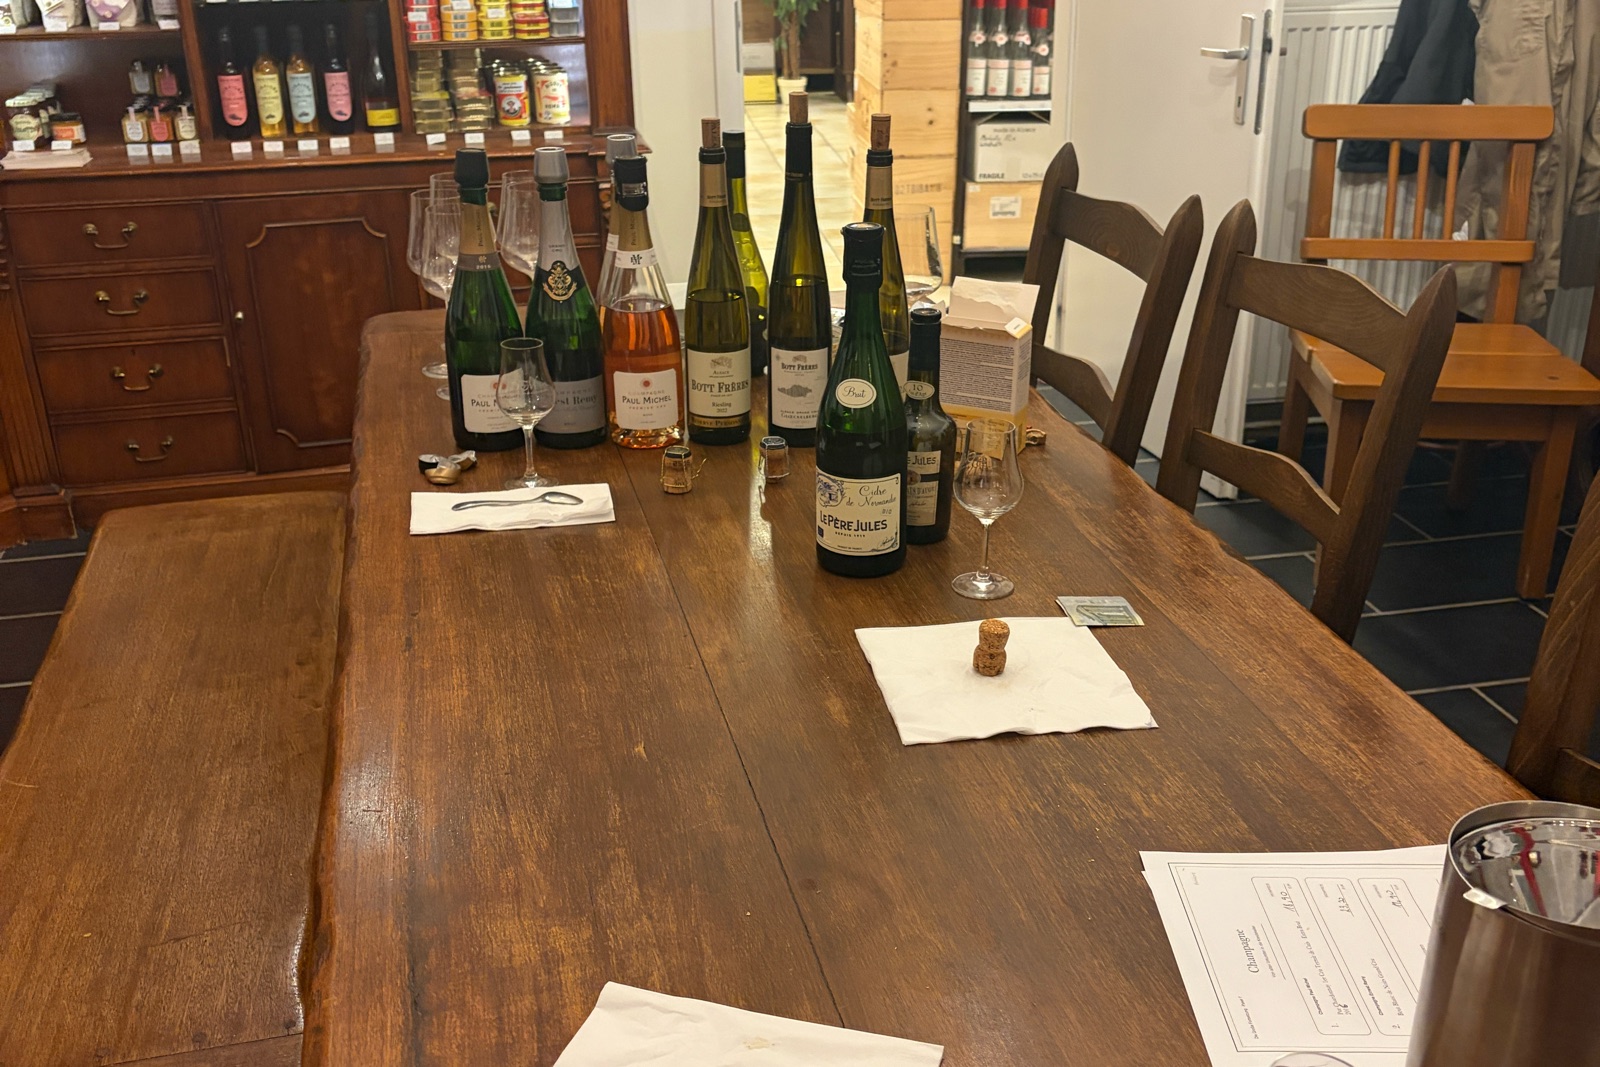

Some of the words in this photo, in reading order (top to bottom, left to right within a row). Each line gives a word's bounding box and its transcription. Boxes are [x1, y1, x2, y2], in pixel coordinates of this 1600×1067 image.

[781, 362, 796, 370] BOTT
[691, 379, 715, 393] BOTT
[842, 386, 866, 399] Brut
[471, 399, 491, 407] PAUL
[622, 395, 641, 404] PAUL
[642, 395, 672, 404] MICHEL
[912, 455, 937, 466] JULES
[859, 485, 887, 496] Cidre
[846, 497, 854, 507] de
[854, 519, 888, 532] JULES
[1236, 929, 1260, 973] Champagne
[1303, 978, 1311, 988] Michel
[1326, 984, 1340, 1008] Chardonnay
[1390, 995, 1399, 1006] Blanc
[1312, 996, 1323, 1015] Champagne
[1371, 996, 1384, 1016] Champagne
